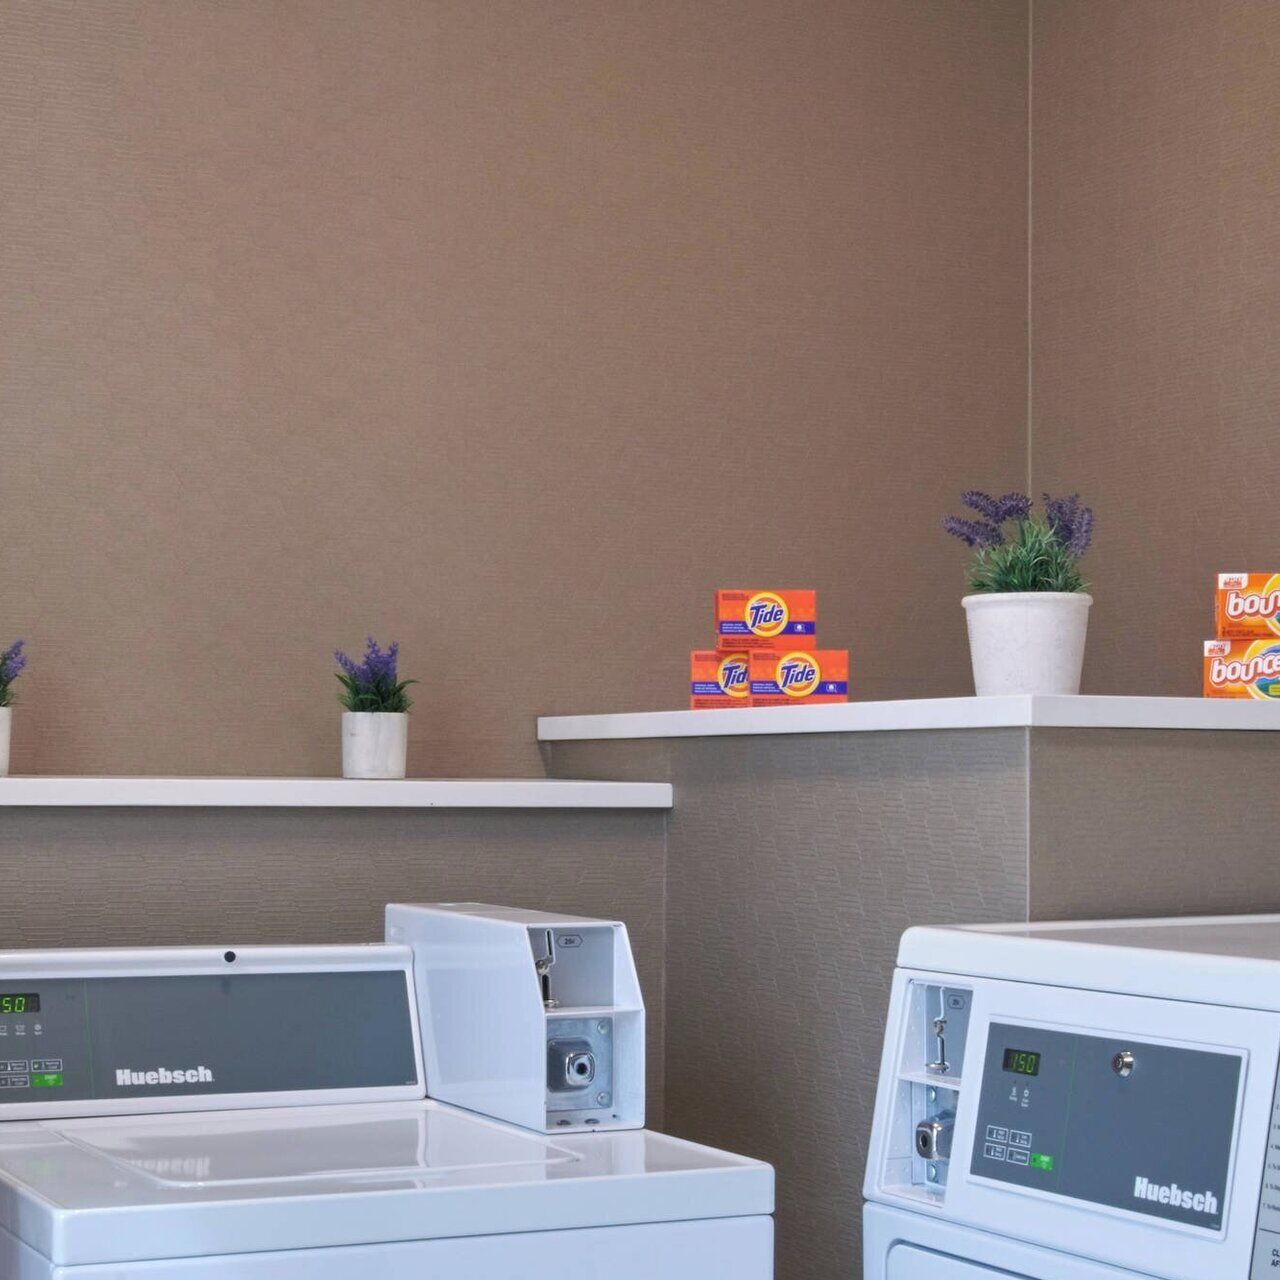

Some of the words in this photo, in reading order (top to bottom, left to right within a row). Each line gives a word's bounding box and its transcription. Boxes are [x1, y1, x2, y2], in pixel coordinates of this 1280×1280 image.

[750, 604, 784, 628] Tide
[723, 664, 748, 688] Tid
[781, 664, 816, 688] Tide
[1012, 1053, 1036, 1073] 150
[116, 1066, 213, 1086] Huebsch
[1134, 1176, 1218, 1214] Huebsch
